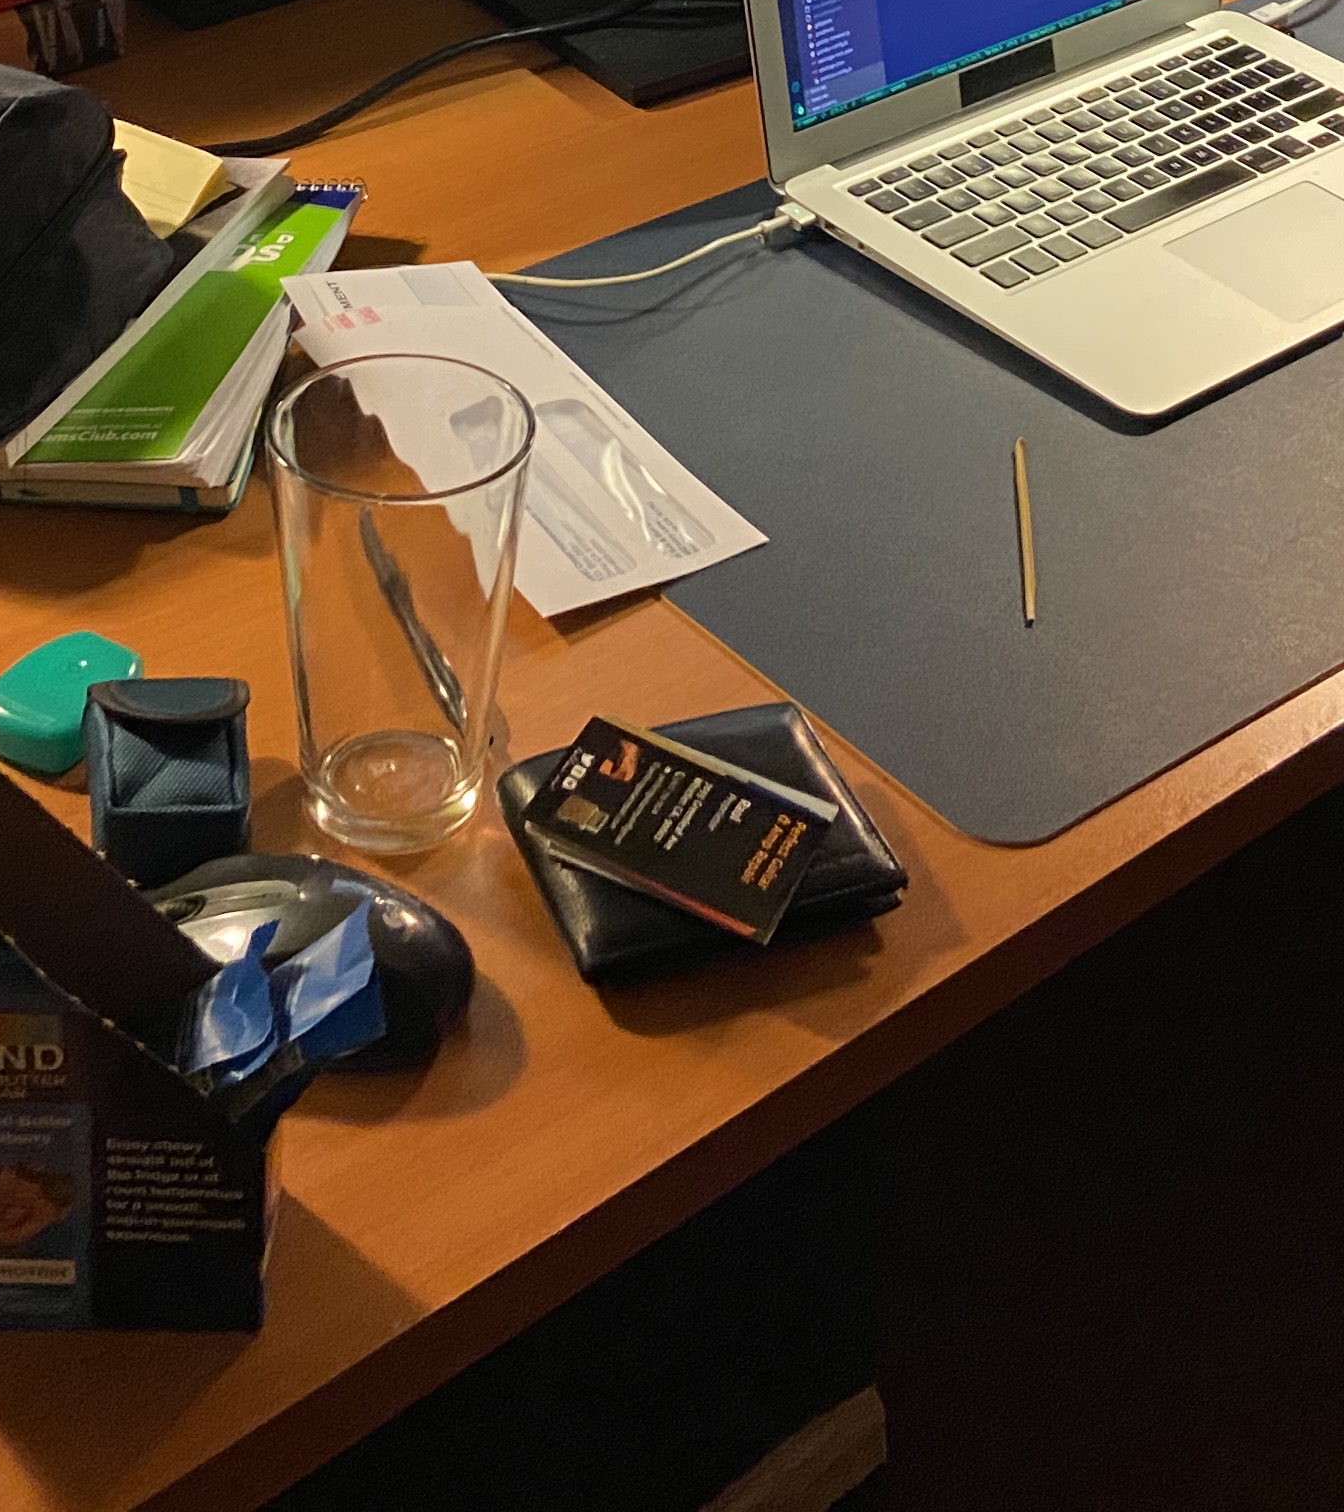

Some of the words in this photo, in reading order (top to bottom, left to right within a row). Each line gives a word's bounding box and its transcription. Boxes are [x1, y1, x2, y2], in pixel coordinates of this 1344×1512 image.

[44, 431, 157, 442] amsClub.com
[761, 825, 784, 850] Amp
[741, 850, 769, 885] Repair
[758, 857, 784, 890] Guitar
